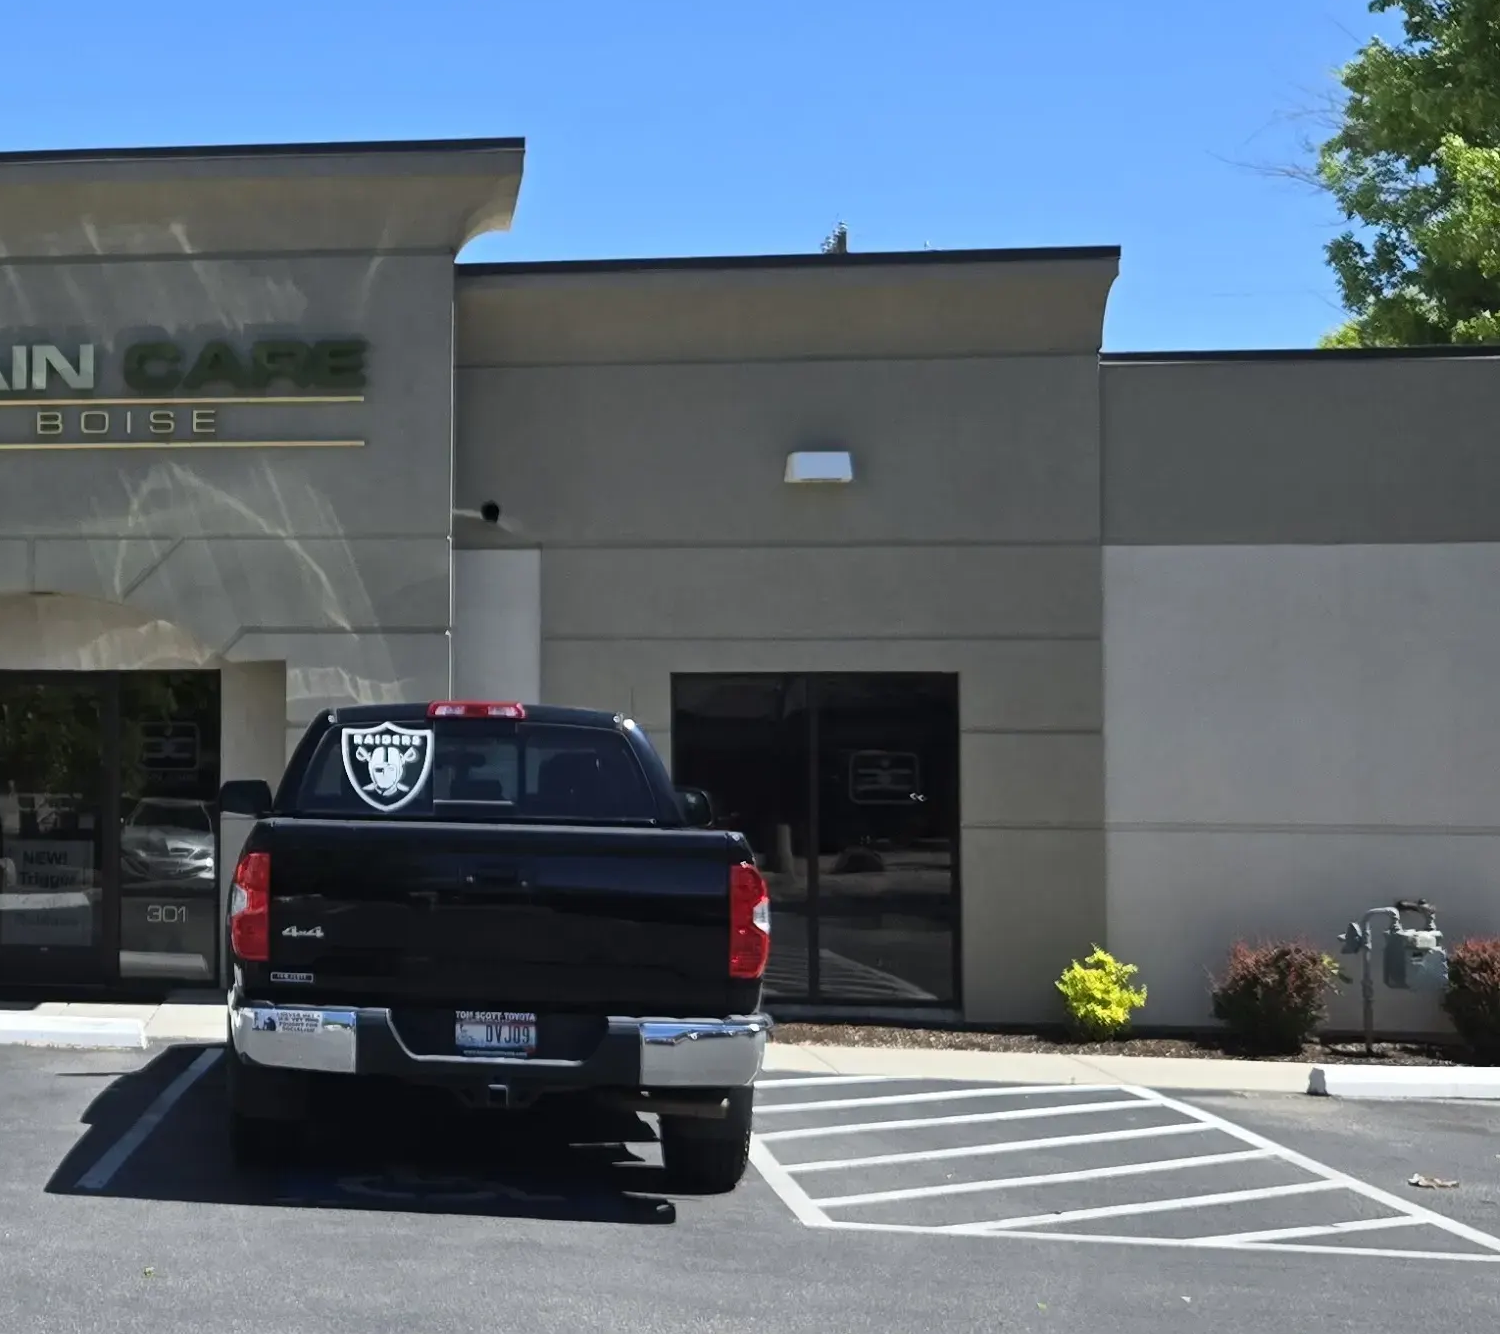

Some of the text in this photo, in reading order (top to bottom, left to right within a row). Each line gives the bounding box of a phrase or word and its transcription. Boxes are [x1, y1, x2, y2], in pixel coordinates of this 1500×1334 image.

[123, 339, 367, 390] CARE
[36, 410, 217, 435] BOISE
[353, 734, 421, 746] RAIDERS
[147, 905, 187, 923] 301
[455, 1011, 537, 1022] TOM SCOTT TOYOTA
[485, 1024, 531, 1044] DVJ09
